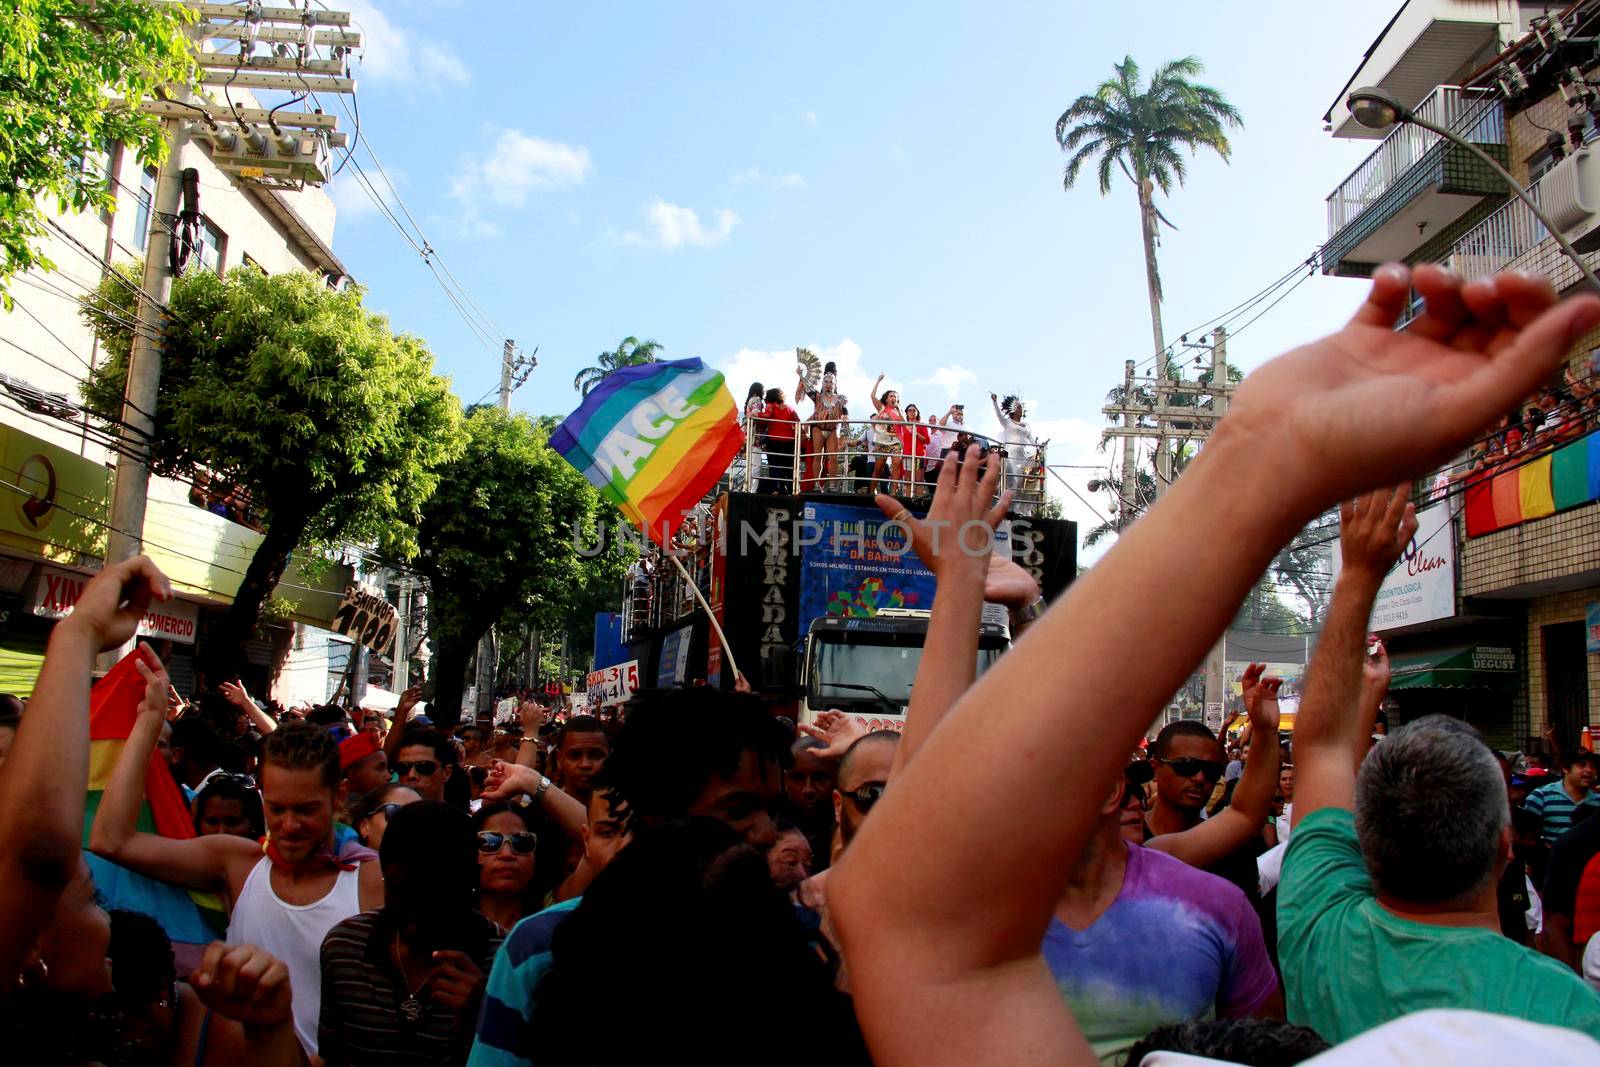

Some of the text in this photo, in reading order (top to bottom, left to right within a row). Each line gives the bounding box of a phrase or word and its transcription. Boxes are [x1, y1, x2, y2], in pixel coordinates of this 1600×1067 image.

[850, 549, 900, 563] DA BAHIA
[1408, 550, 1446, 577] Clean
[1473, 659, 1516, 670] DEGUST
[587, 670, 606, 687] SKOL
[608, 667, 619, 682] 3
[628, 664, 641, 694] 5
[608, 684, 619, 698] 4
